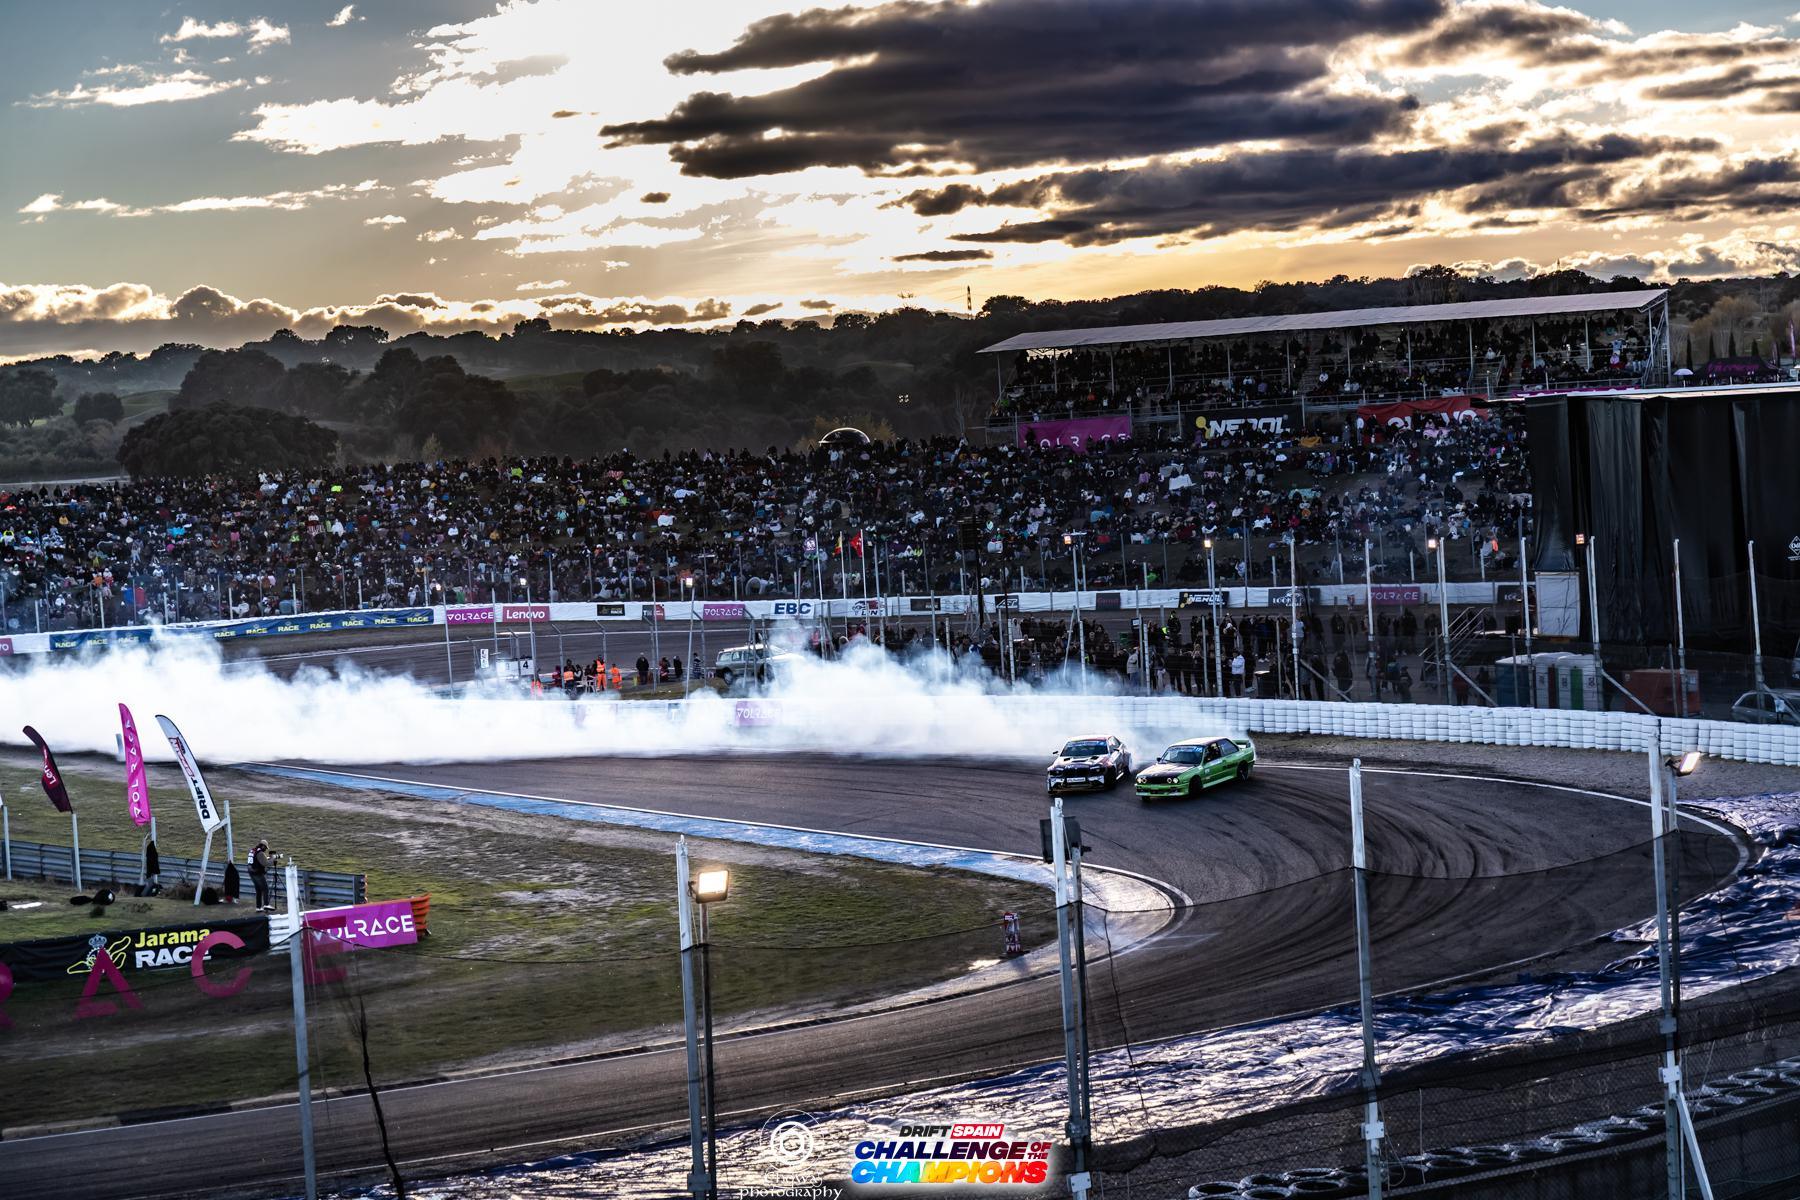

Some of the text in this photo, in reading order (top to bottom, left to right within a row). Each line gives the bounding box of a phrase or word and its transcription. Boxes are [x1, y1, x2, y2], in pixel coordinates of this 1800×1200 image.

[506, 606, 546, 619] Lenovo
[703, 608, 743, 616] VOLRACE
[773, 602, 814, 615] EBC
[446, 611, 494, 622] VOLRACE
[522, 660, 529, 669] 4
[190, 777, 211, 820] DRIFT
[134, 928, 211, 953] Jarama
